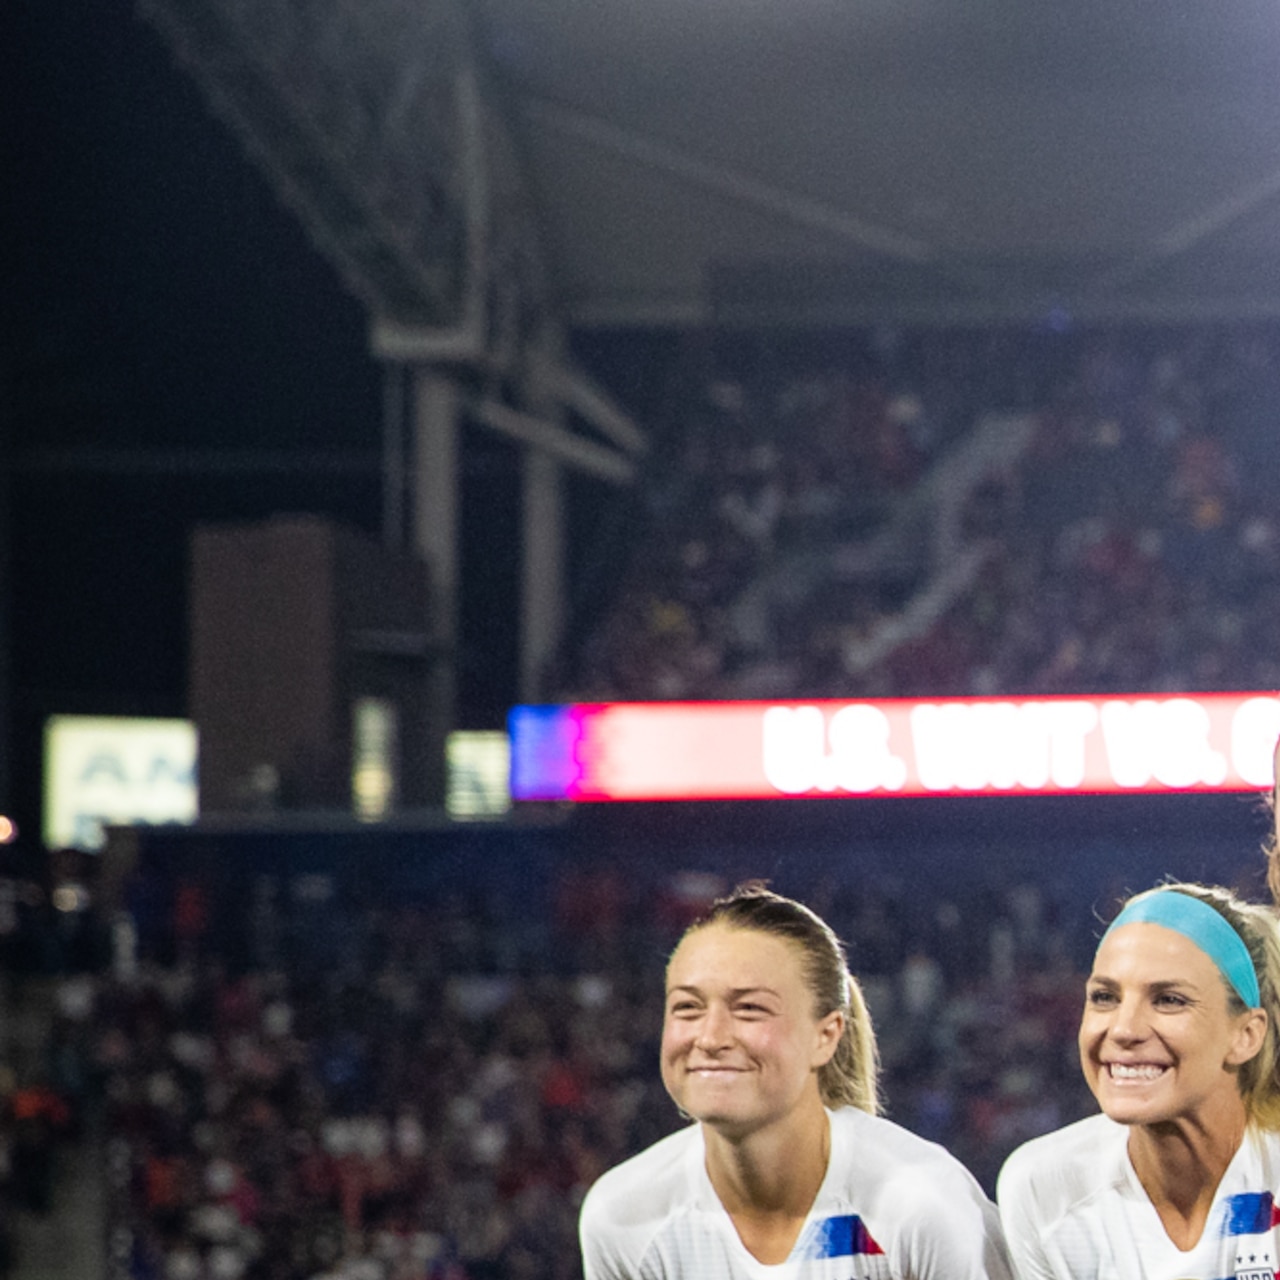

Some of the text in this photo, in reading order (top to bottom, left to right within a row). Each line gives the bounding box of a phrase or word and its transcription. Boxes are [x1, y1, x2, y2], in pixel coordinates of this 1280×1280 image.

[763, 704, 906, 794] U.S.
[911, 700, 1098, 790] WNT
[1101, 697, 1227, 789] VS.
